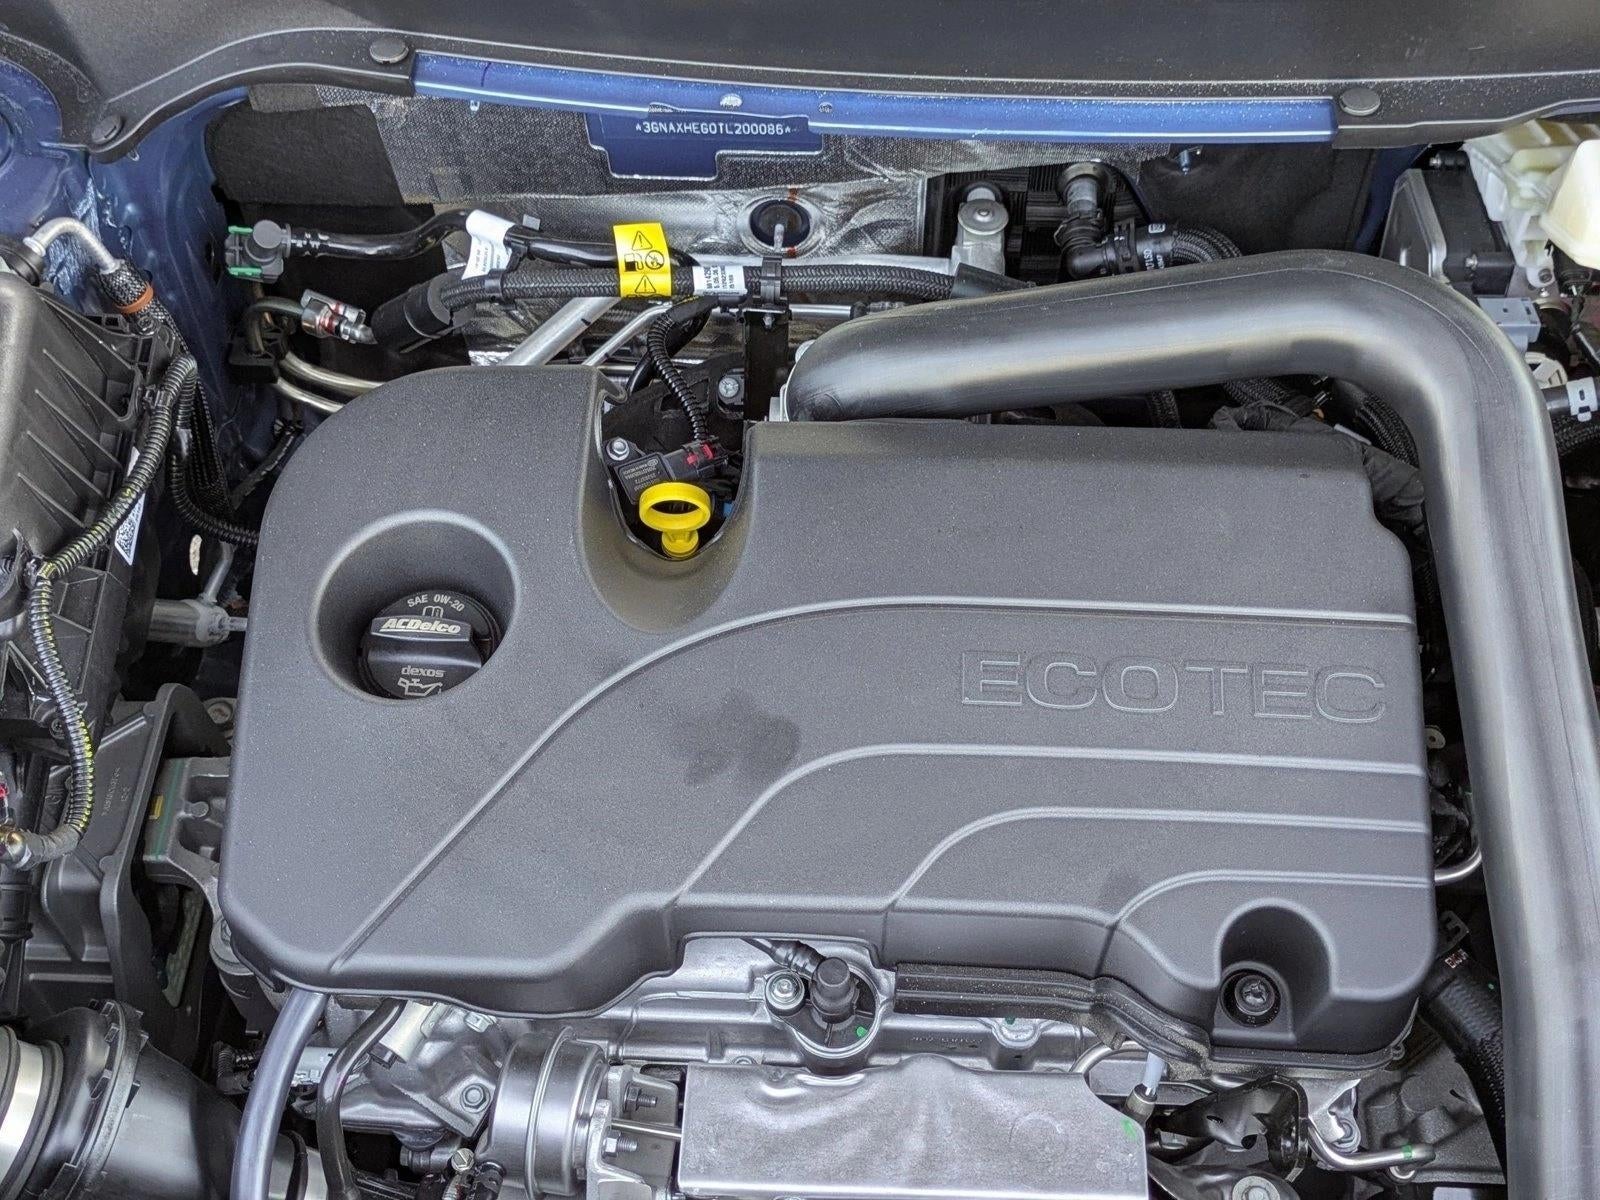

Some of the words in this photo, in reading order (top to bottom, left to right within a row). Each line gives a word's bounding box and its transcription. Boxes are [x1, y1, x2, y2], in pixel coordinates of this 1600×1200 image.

[407, 594, 429, 608] SAE
[433, 593, 466, 613] 0W-20
[380, 618, 462, 635] ACDelco
[401, 665, 446, 678] dexos
[961, 650, 1387, 724] ECOTEC
